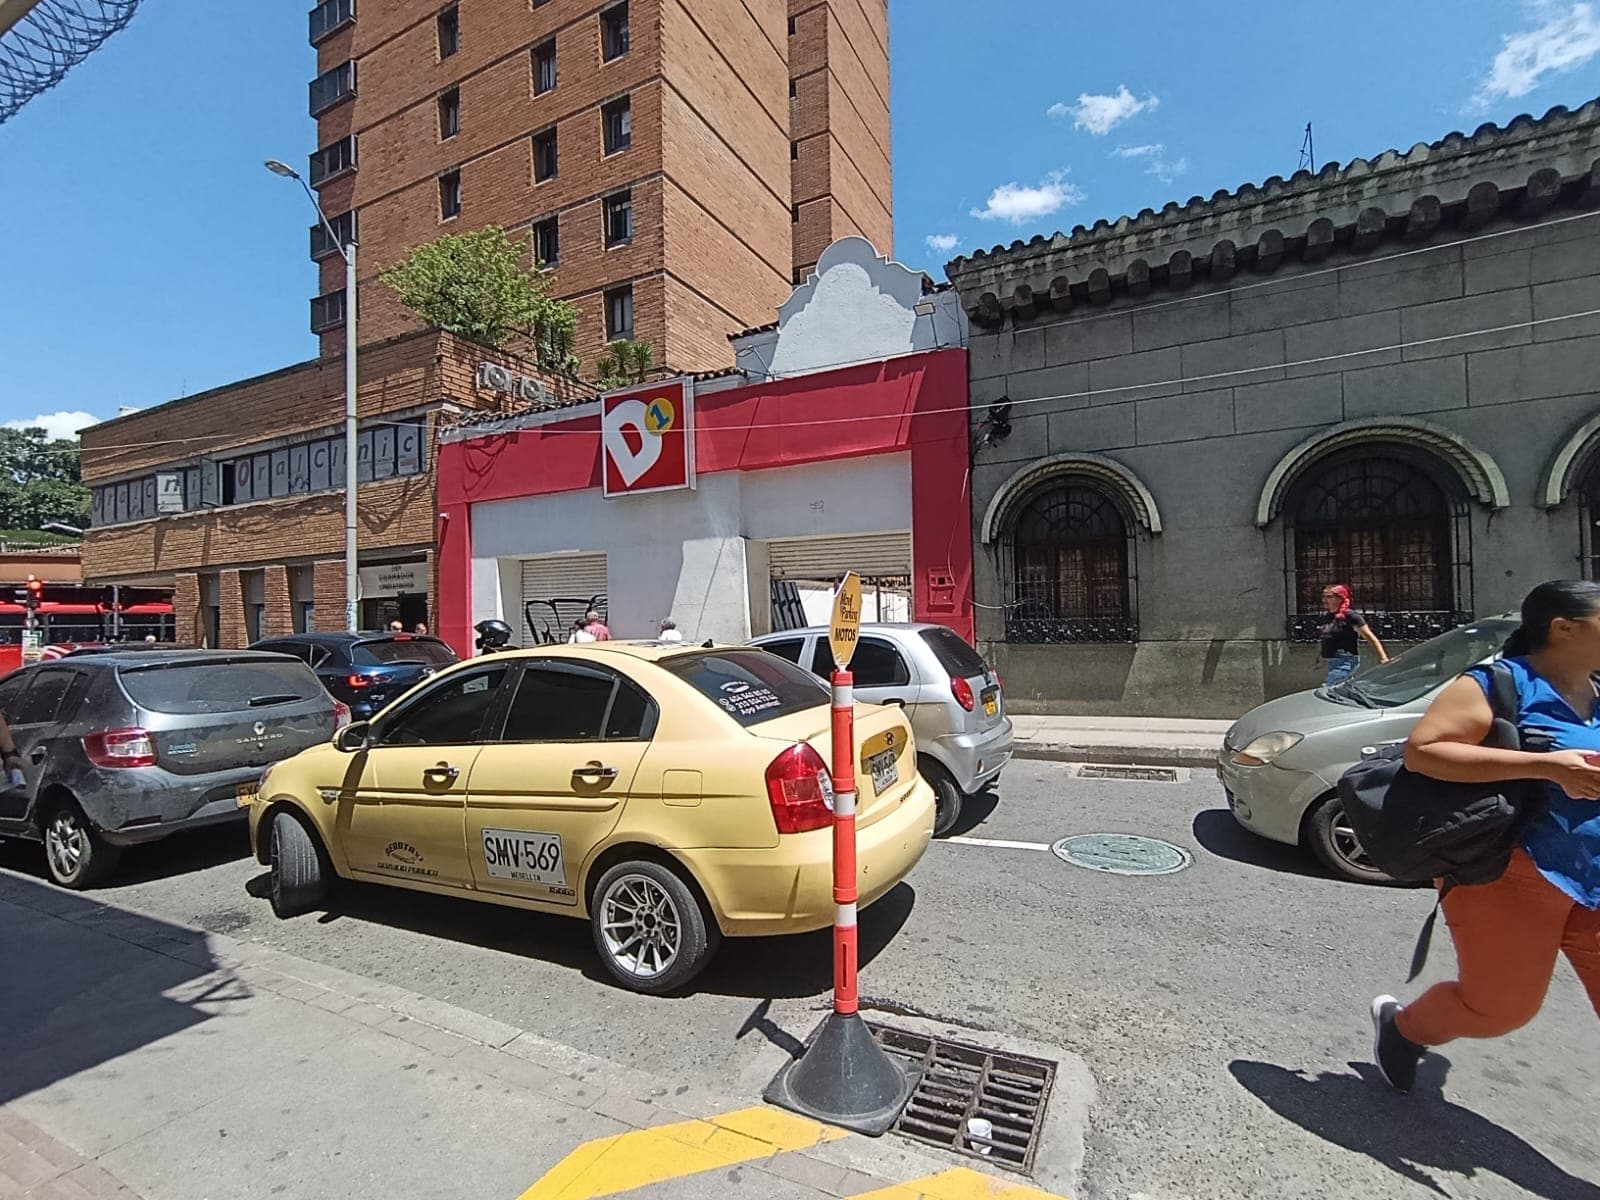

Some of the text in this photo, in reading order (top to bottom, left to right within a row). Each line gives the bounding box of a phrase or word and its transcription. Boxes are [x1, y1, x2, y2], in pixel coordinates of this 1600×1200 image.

[605, 399, 670, 487] D1
[834, 627, 856, 641] MOTOS
[235, 732, 284, 744] SANDERO
[510, 871, 541, 881] MEDELLIN
